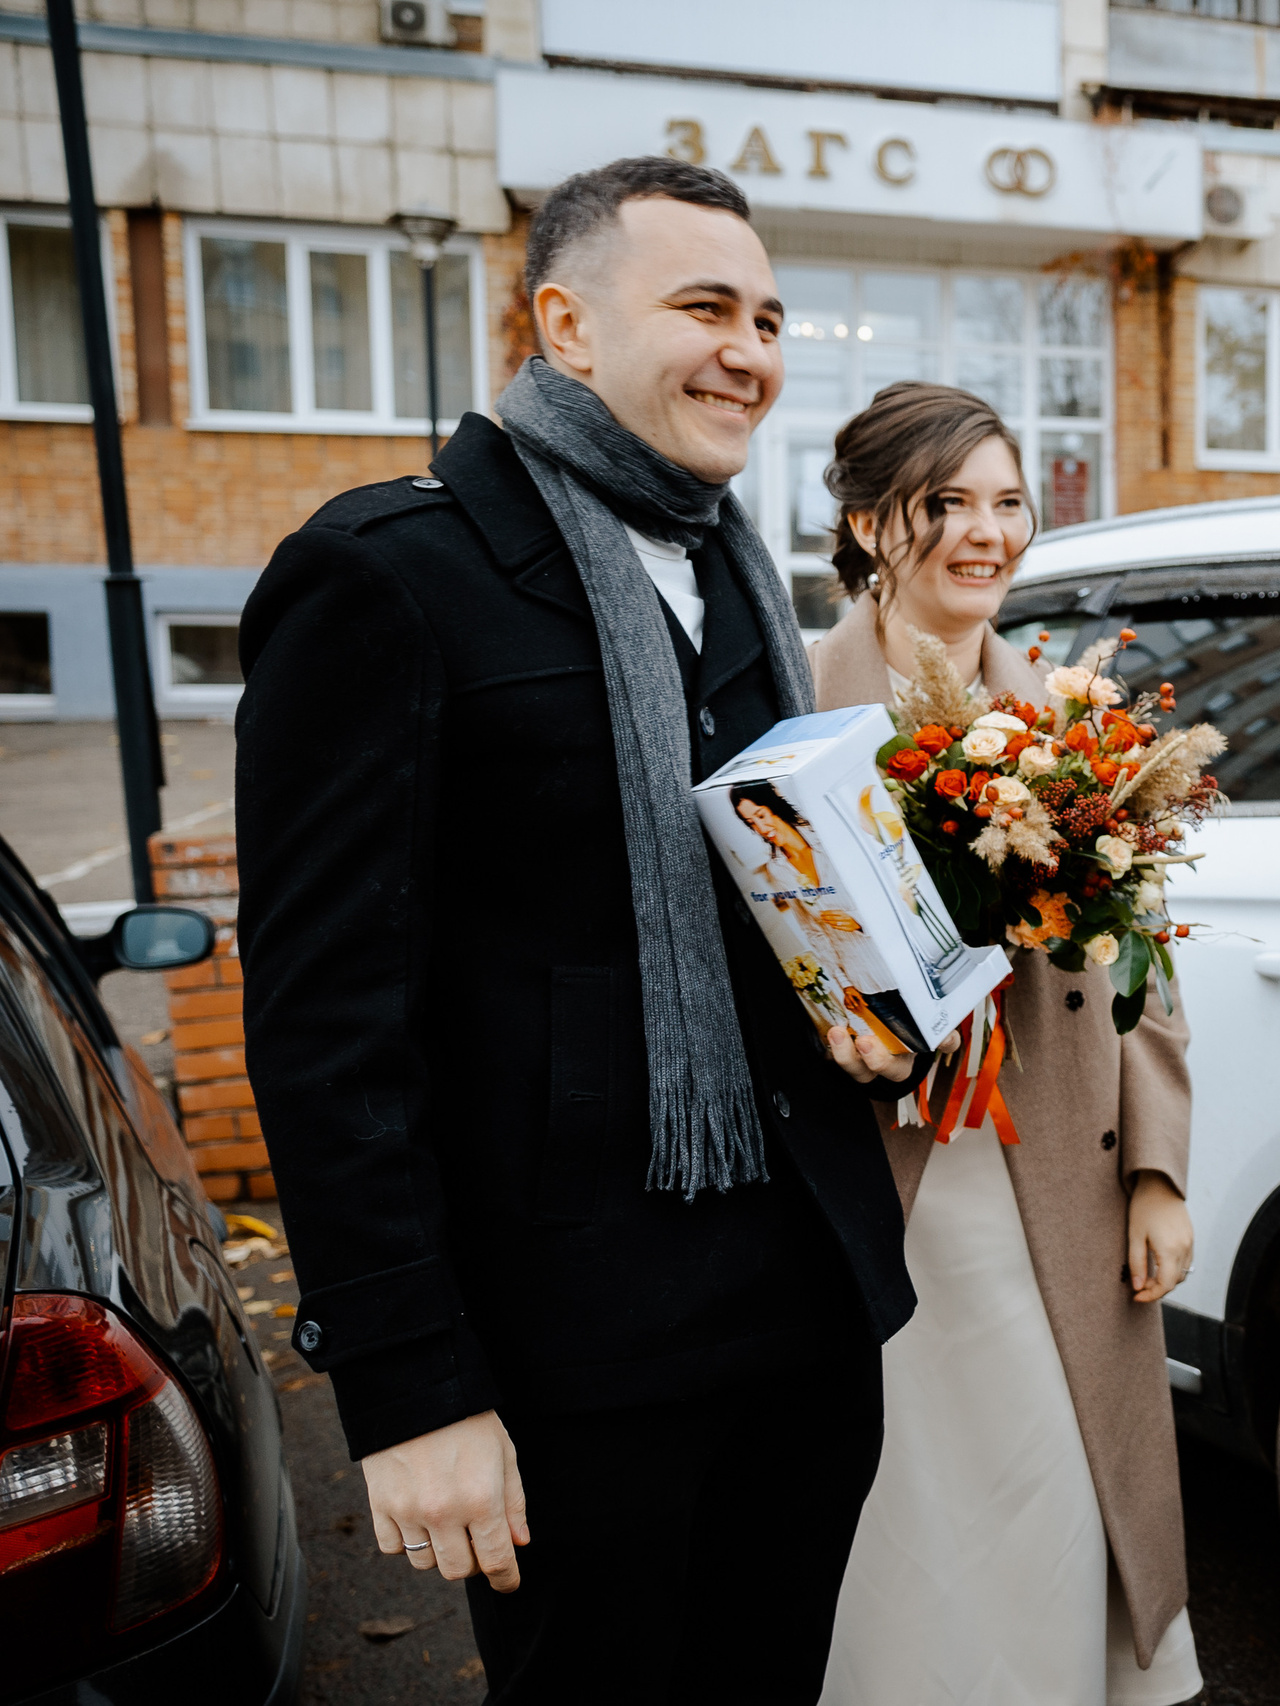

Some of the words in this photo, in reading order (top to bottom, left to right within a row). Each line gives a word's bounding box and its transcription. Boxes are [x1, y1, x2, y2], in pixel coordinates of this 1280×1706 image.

[665, 118, 916, 186] ЗАГС
[750, 891, 769, 902] for
[771, 890, 797, 903] your
[799, 885, 837, 898] home
